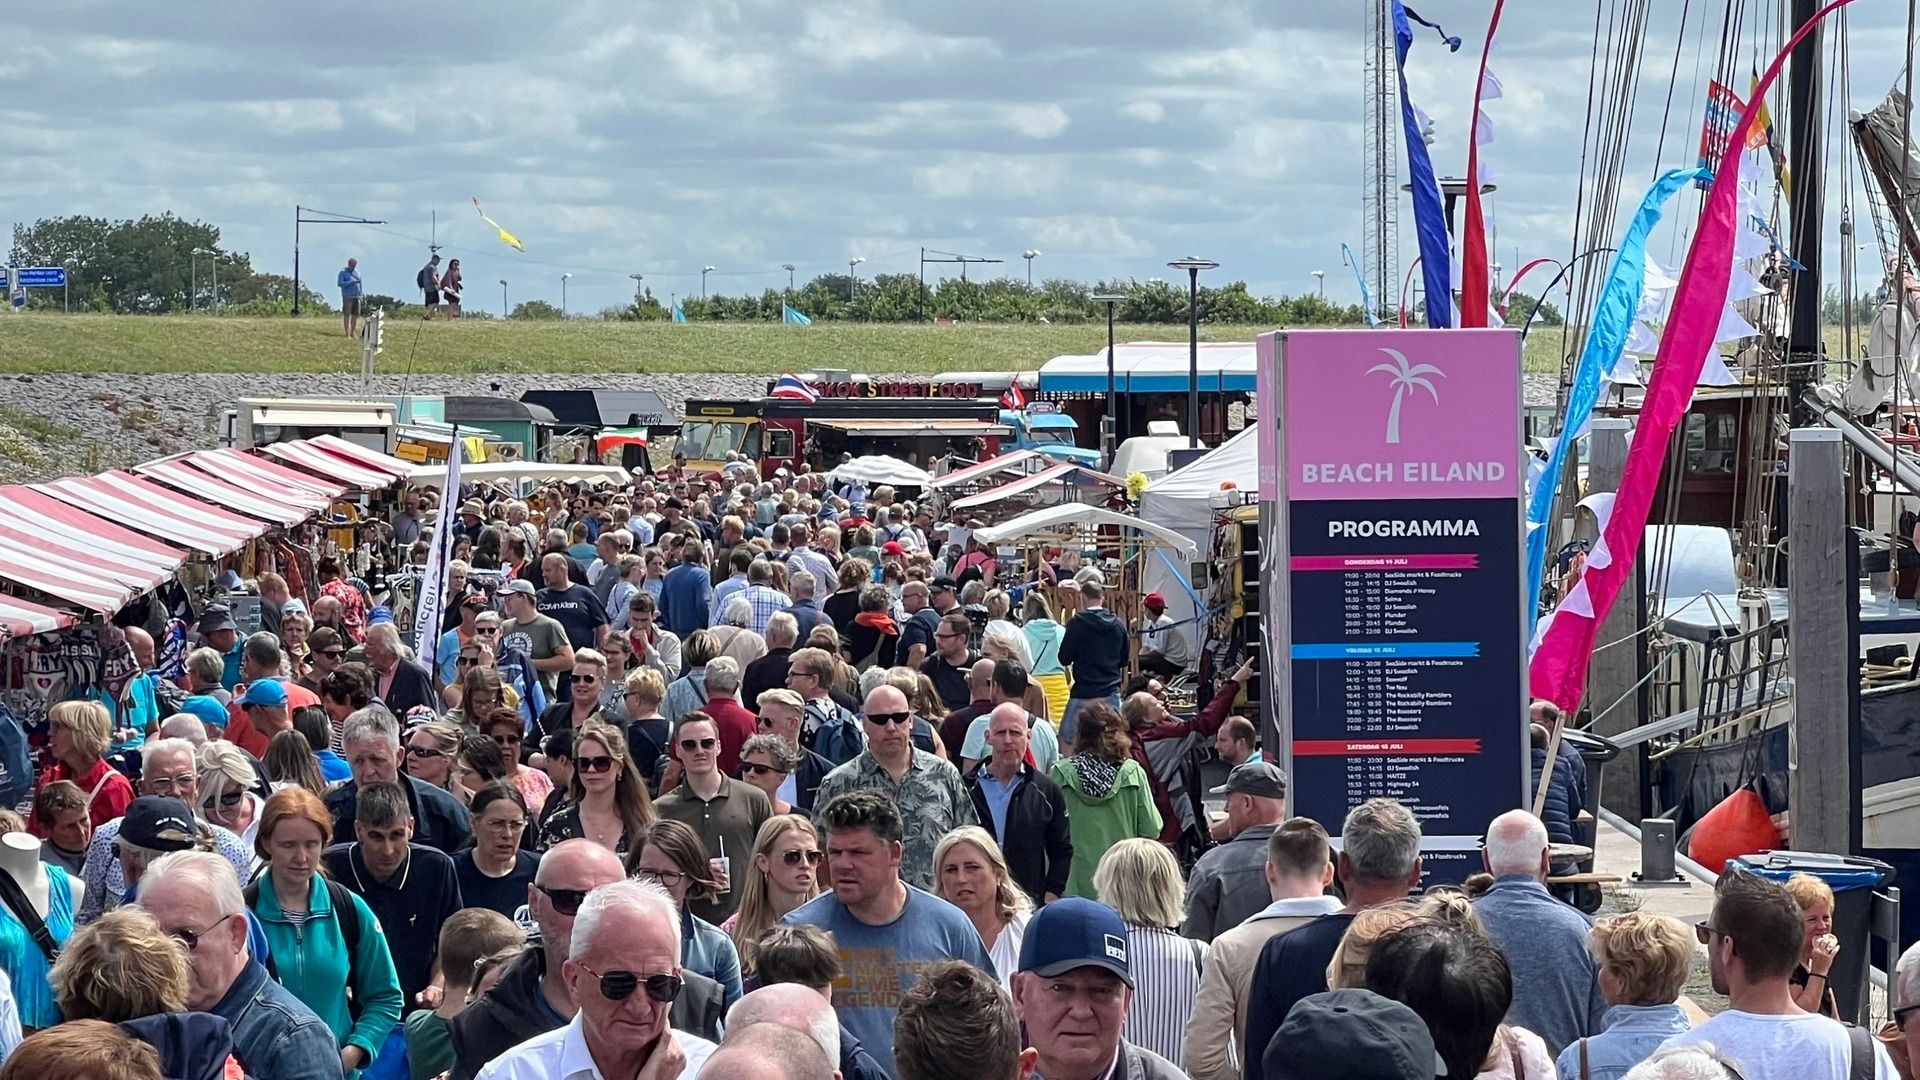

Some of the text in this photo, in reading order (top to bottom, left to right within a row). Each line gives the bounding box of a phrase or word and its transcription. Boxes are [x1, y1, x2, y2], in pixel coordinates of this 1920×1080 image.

[1302, 461, 1505, 483] BEACH EILAND
[1328, 519, 1480, 538] PROGRAMMA
[538, 601, 578, 611] Calvin Klein
